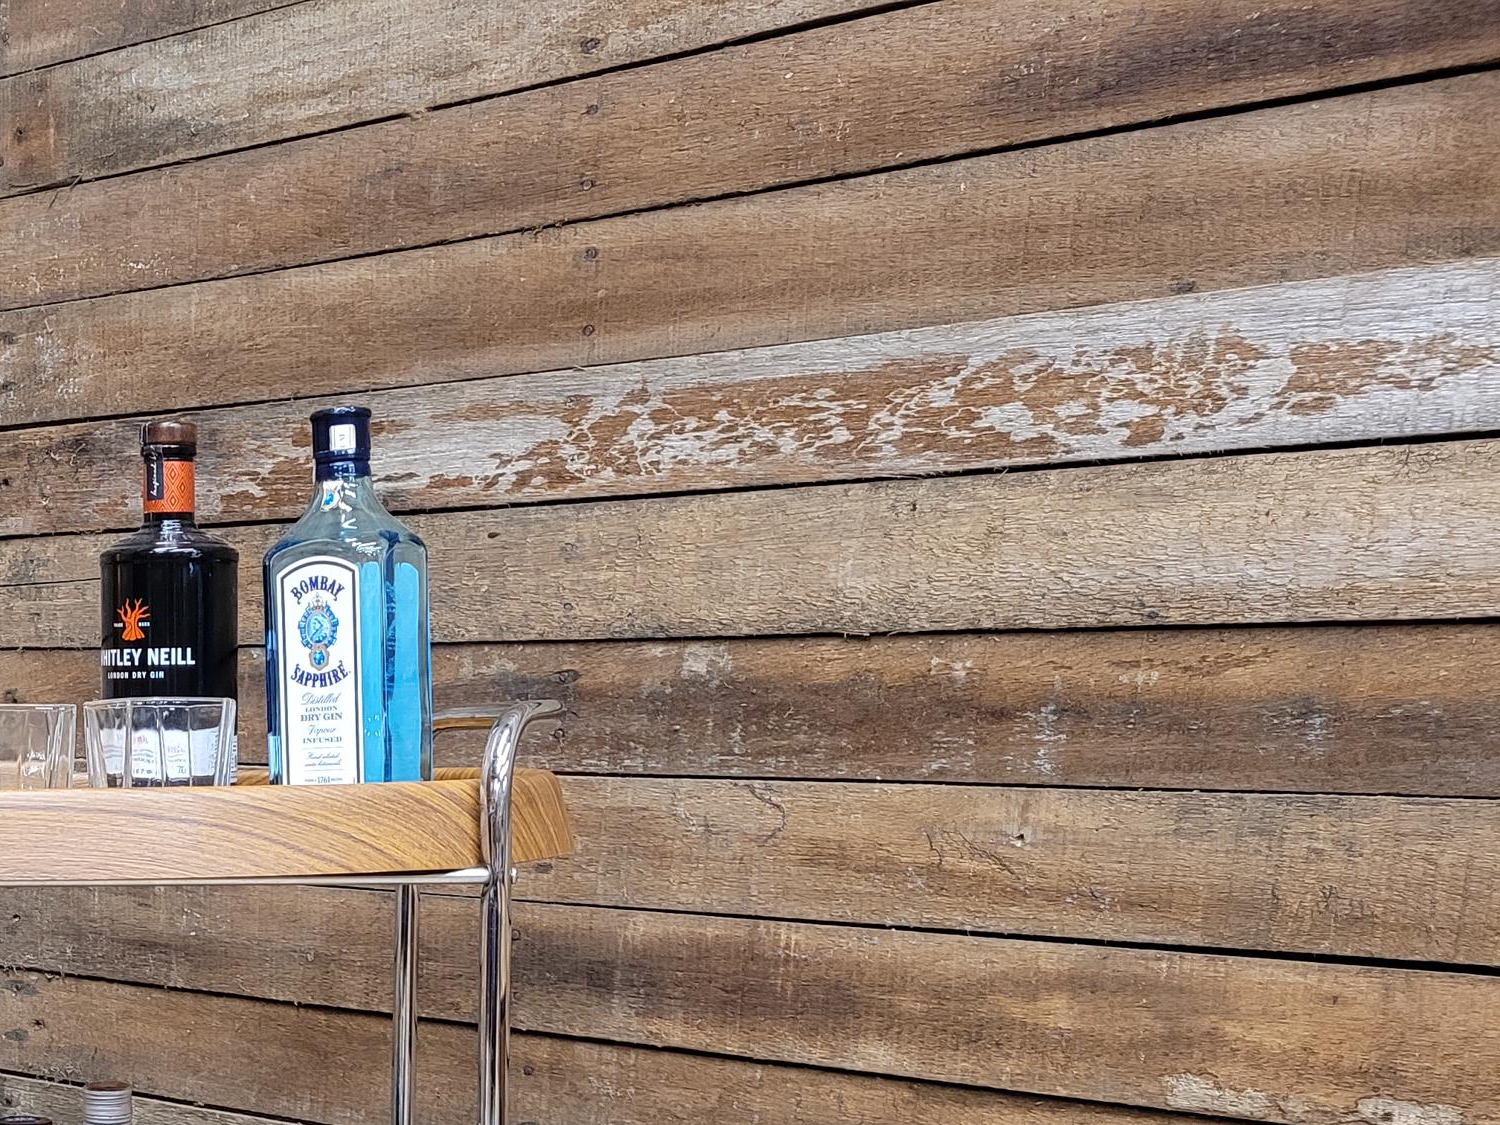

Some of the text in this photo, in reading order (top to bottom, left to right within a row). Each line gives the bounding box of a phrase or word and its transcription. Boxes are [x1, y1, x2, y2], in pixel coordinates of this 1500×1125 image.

[290, 576, 345, 604] BOMBAY
[147, 647, 196, 666] NEILL
[107, 670, 164, 679] LONDON DRY GIN
[290, 660, 348, 688] SAPPHIRE
[301, 692, 342, 705] Distilled
[305, 705, 338, 713] LONDON
[300, 712, 343, 722] DRY GIN
